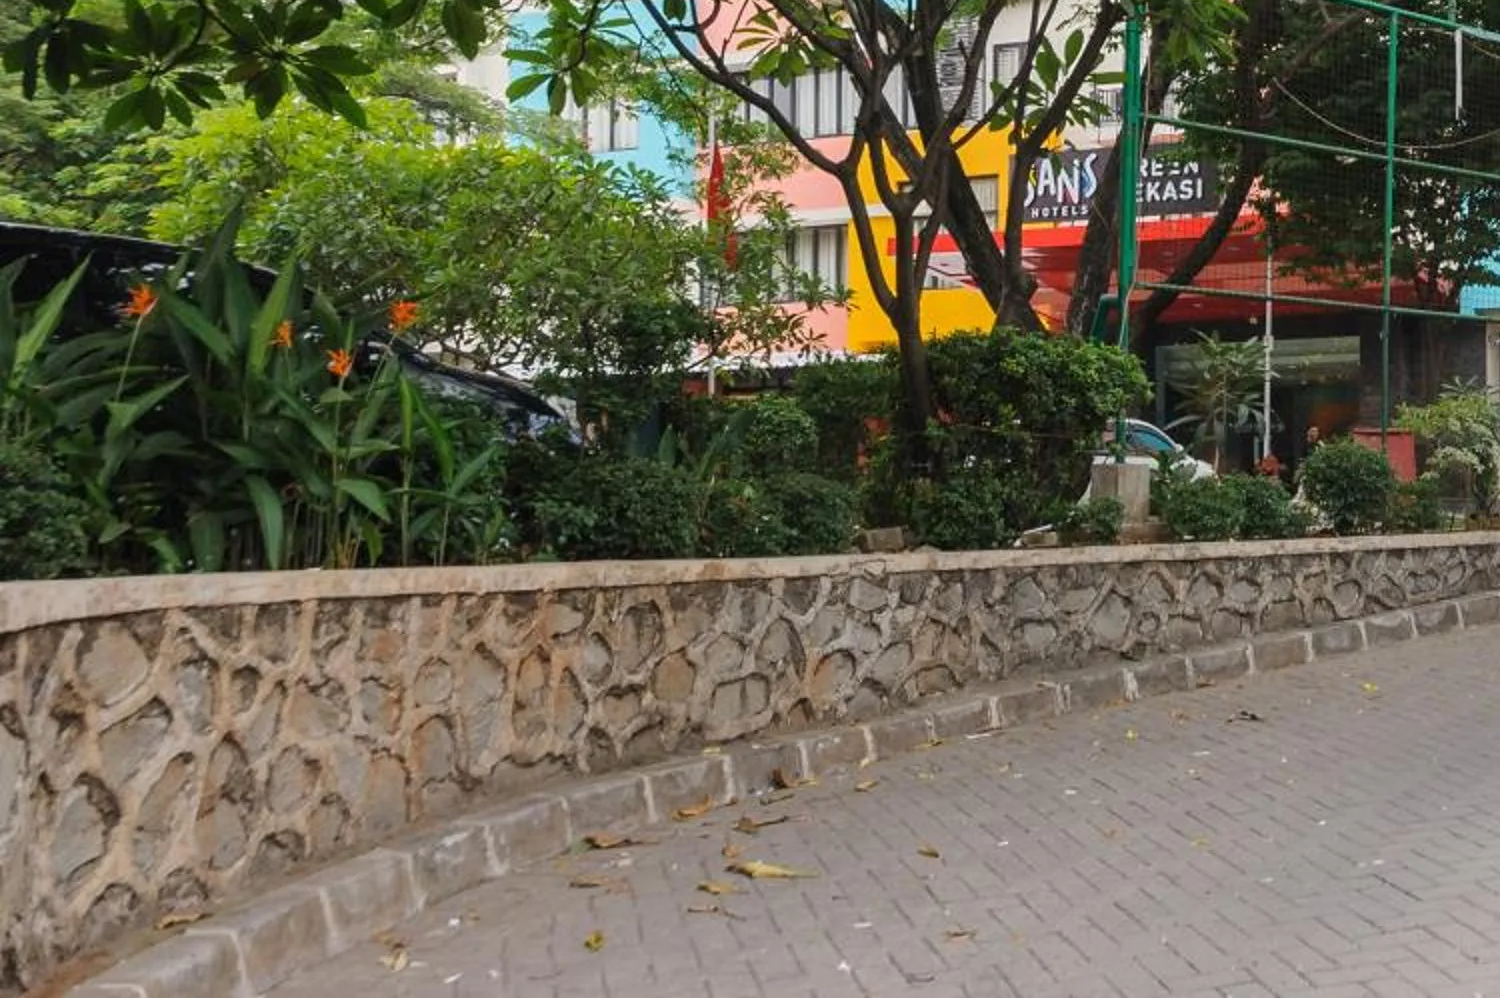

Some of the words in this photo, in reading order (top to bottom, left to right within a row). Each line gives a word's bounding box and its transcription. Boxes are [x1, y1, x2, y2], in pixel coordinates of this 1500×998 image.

[1138, 157, 1199, 177] REEN
[1136, 178, 1203, 202] EKASI
[1031, 205, 1089, 218] HOTELS
